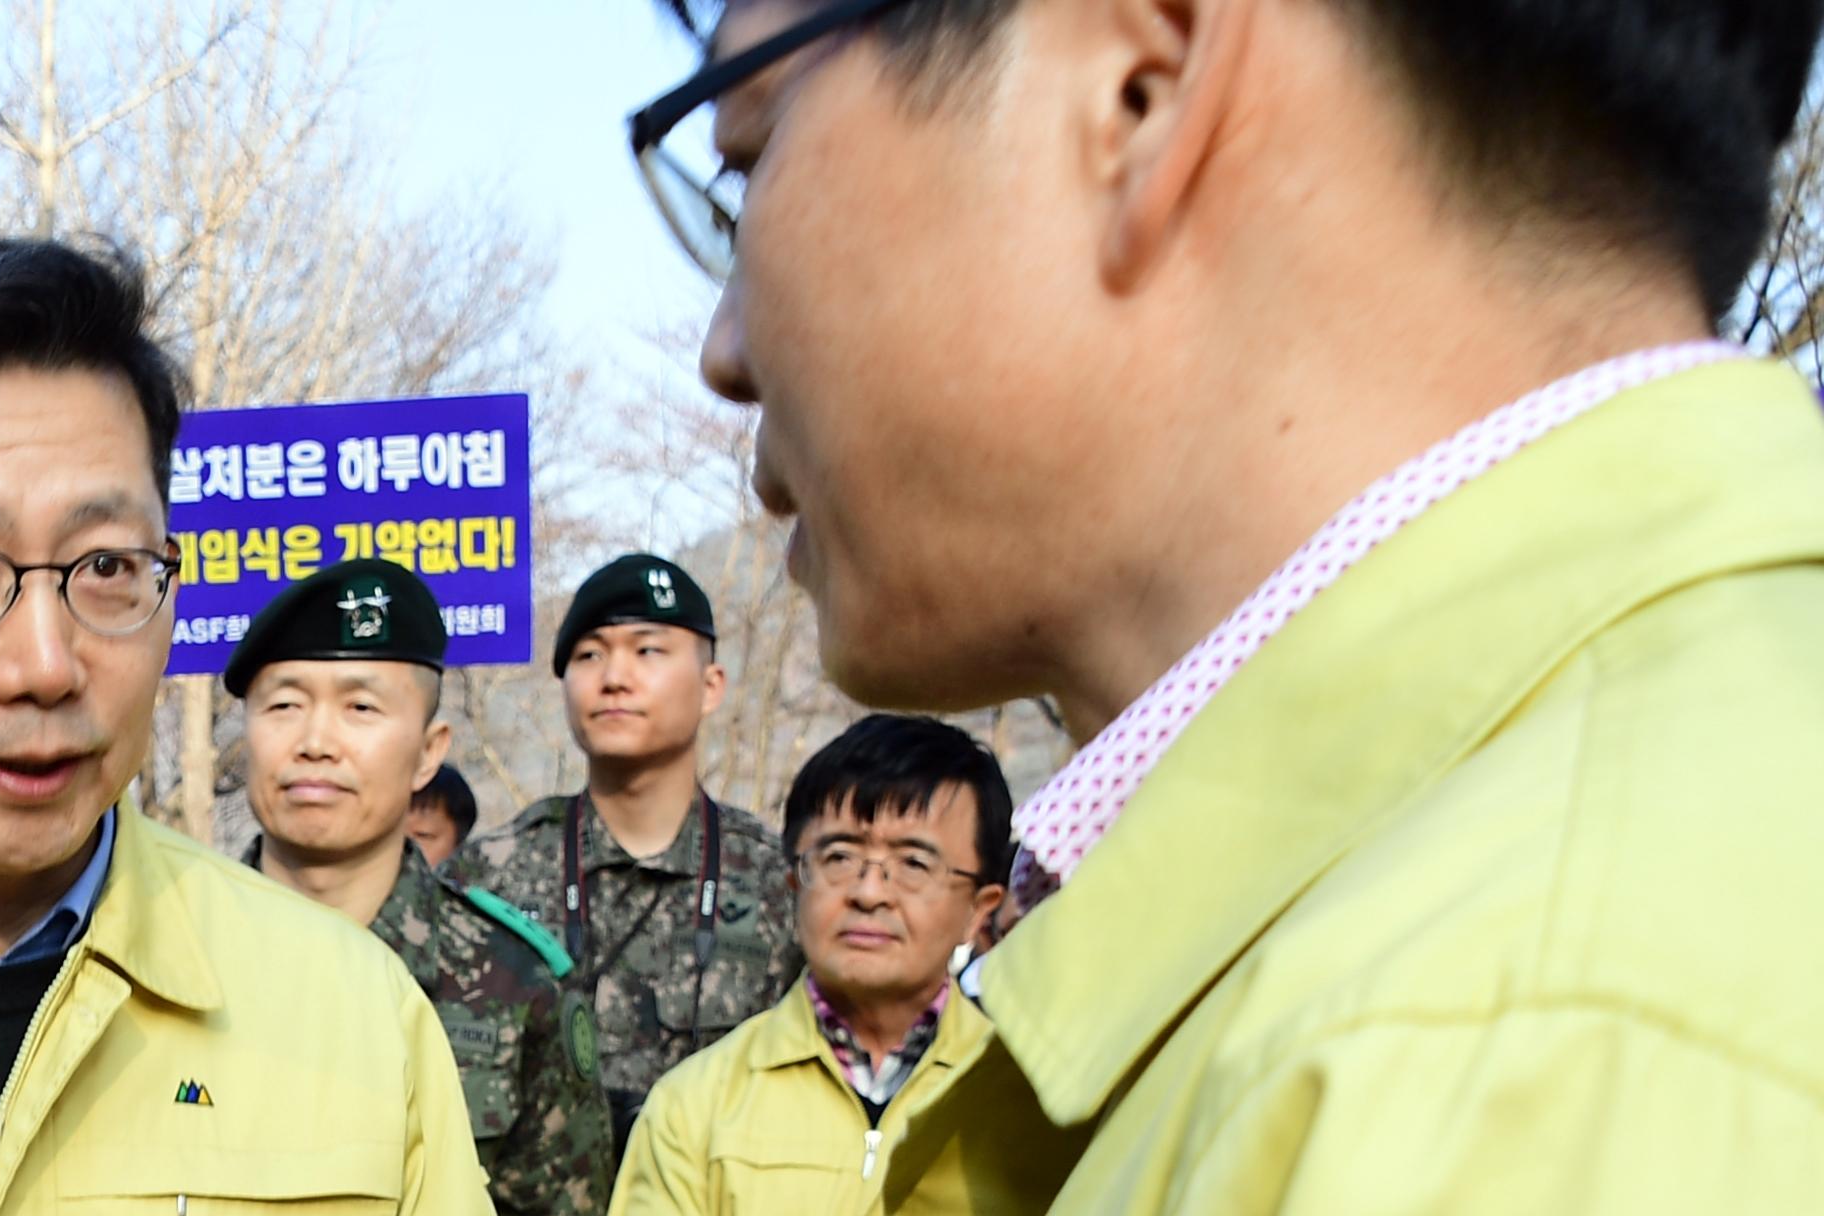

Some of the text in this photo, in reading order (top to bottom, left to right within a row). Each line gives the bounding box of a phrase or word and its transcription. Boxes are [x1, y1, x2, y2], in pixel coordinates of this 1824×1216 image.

[168, 429, 506, 503] 살처분은 하루아침
[334, 515, 515, 574] 기약없다!
